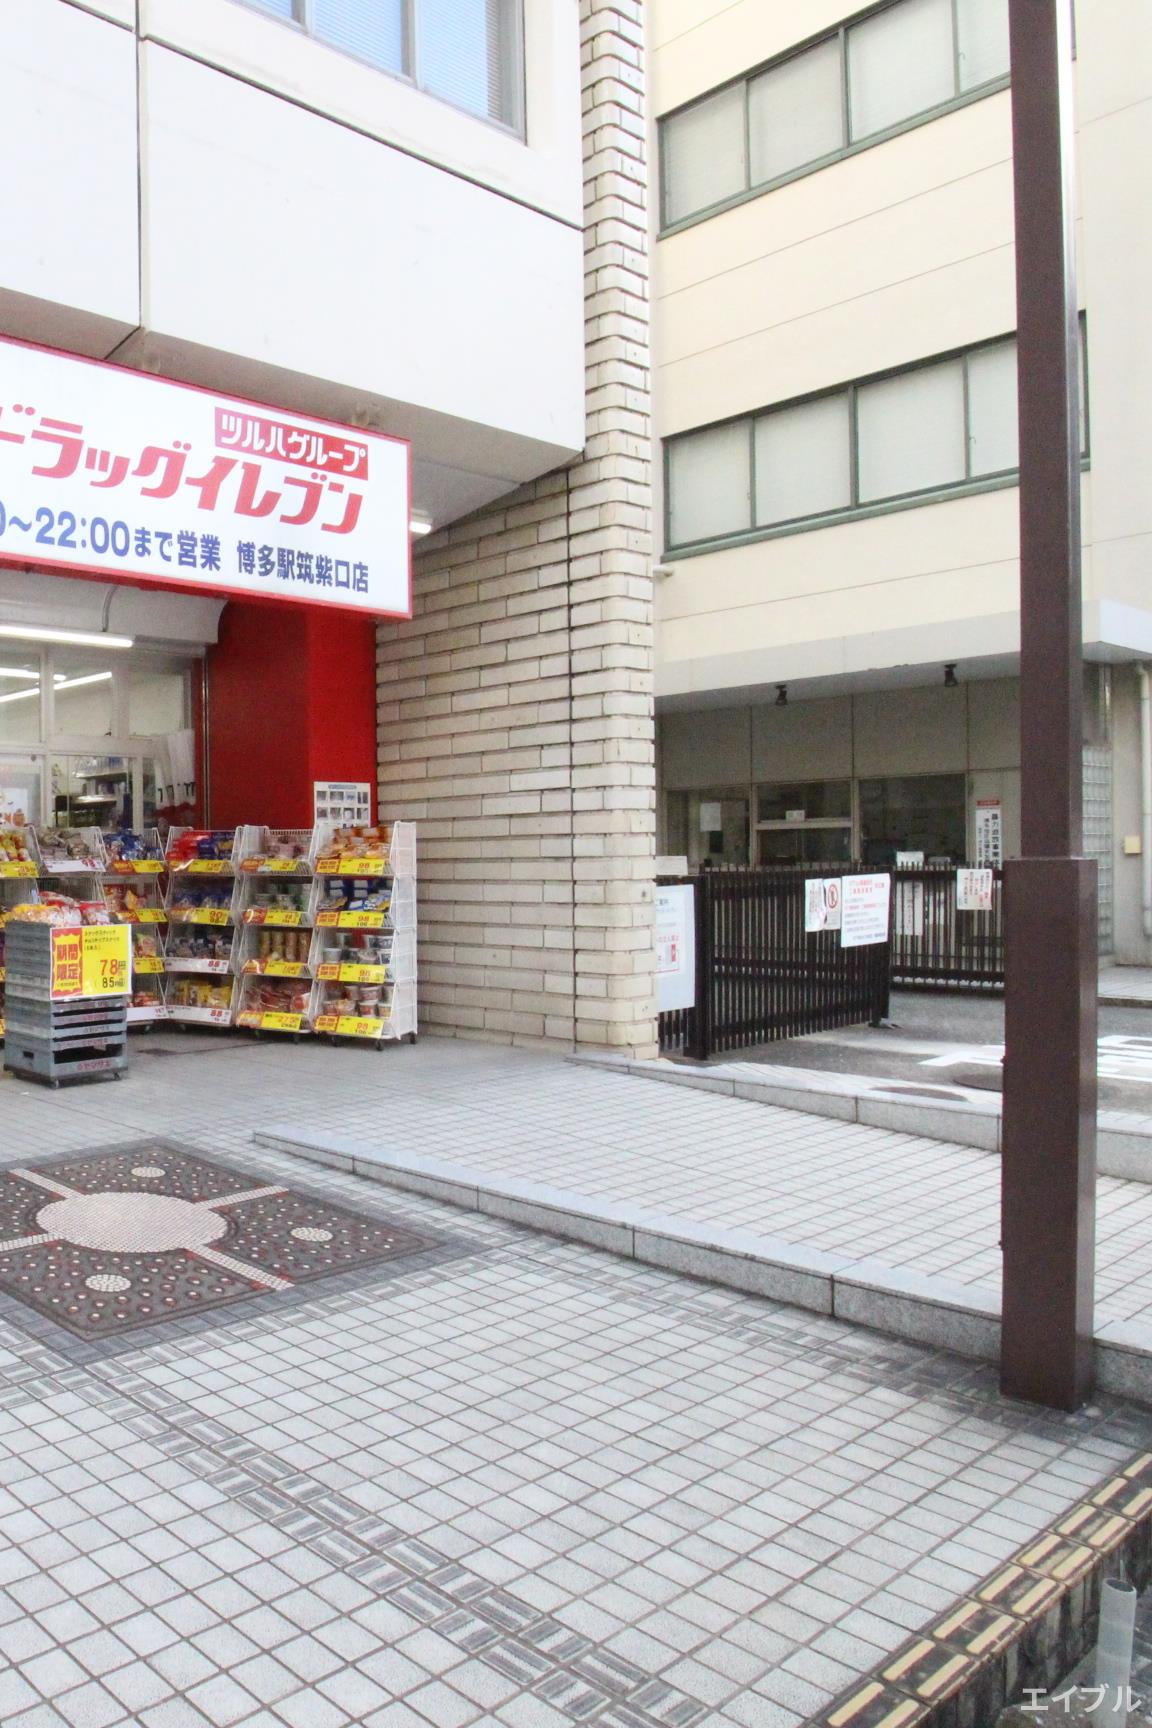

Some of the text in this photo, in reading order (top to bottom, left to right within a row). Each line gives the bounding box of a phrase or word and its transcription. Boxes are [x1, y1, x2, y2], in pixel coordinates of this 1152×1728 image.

[220, 414, 367, 472] ツルハグループ
[236, 540, 369, 594] 博多駅筑紫口店
[56, 944, 79, 961] 期間
[56, 963, 79, 981] 限定
[100, 959, 118, 976] 78
